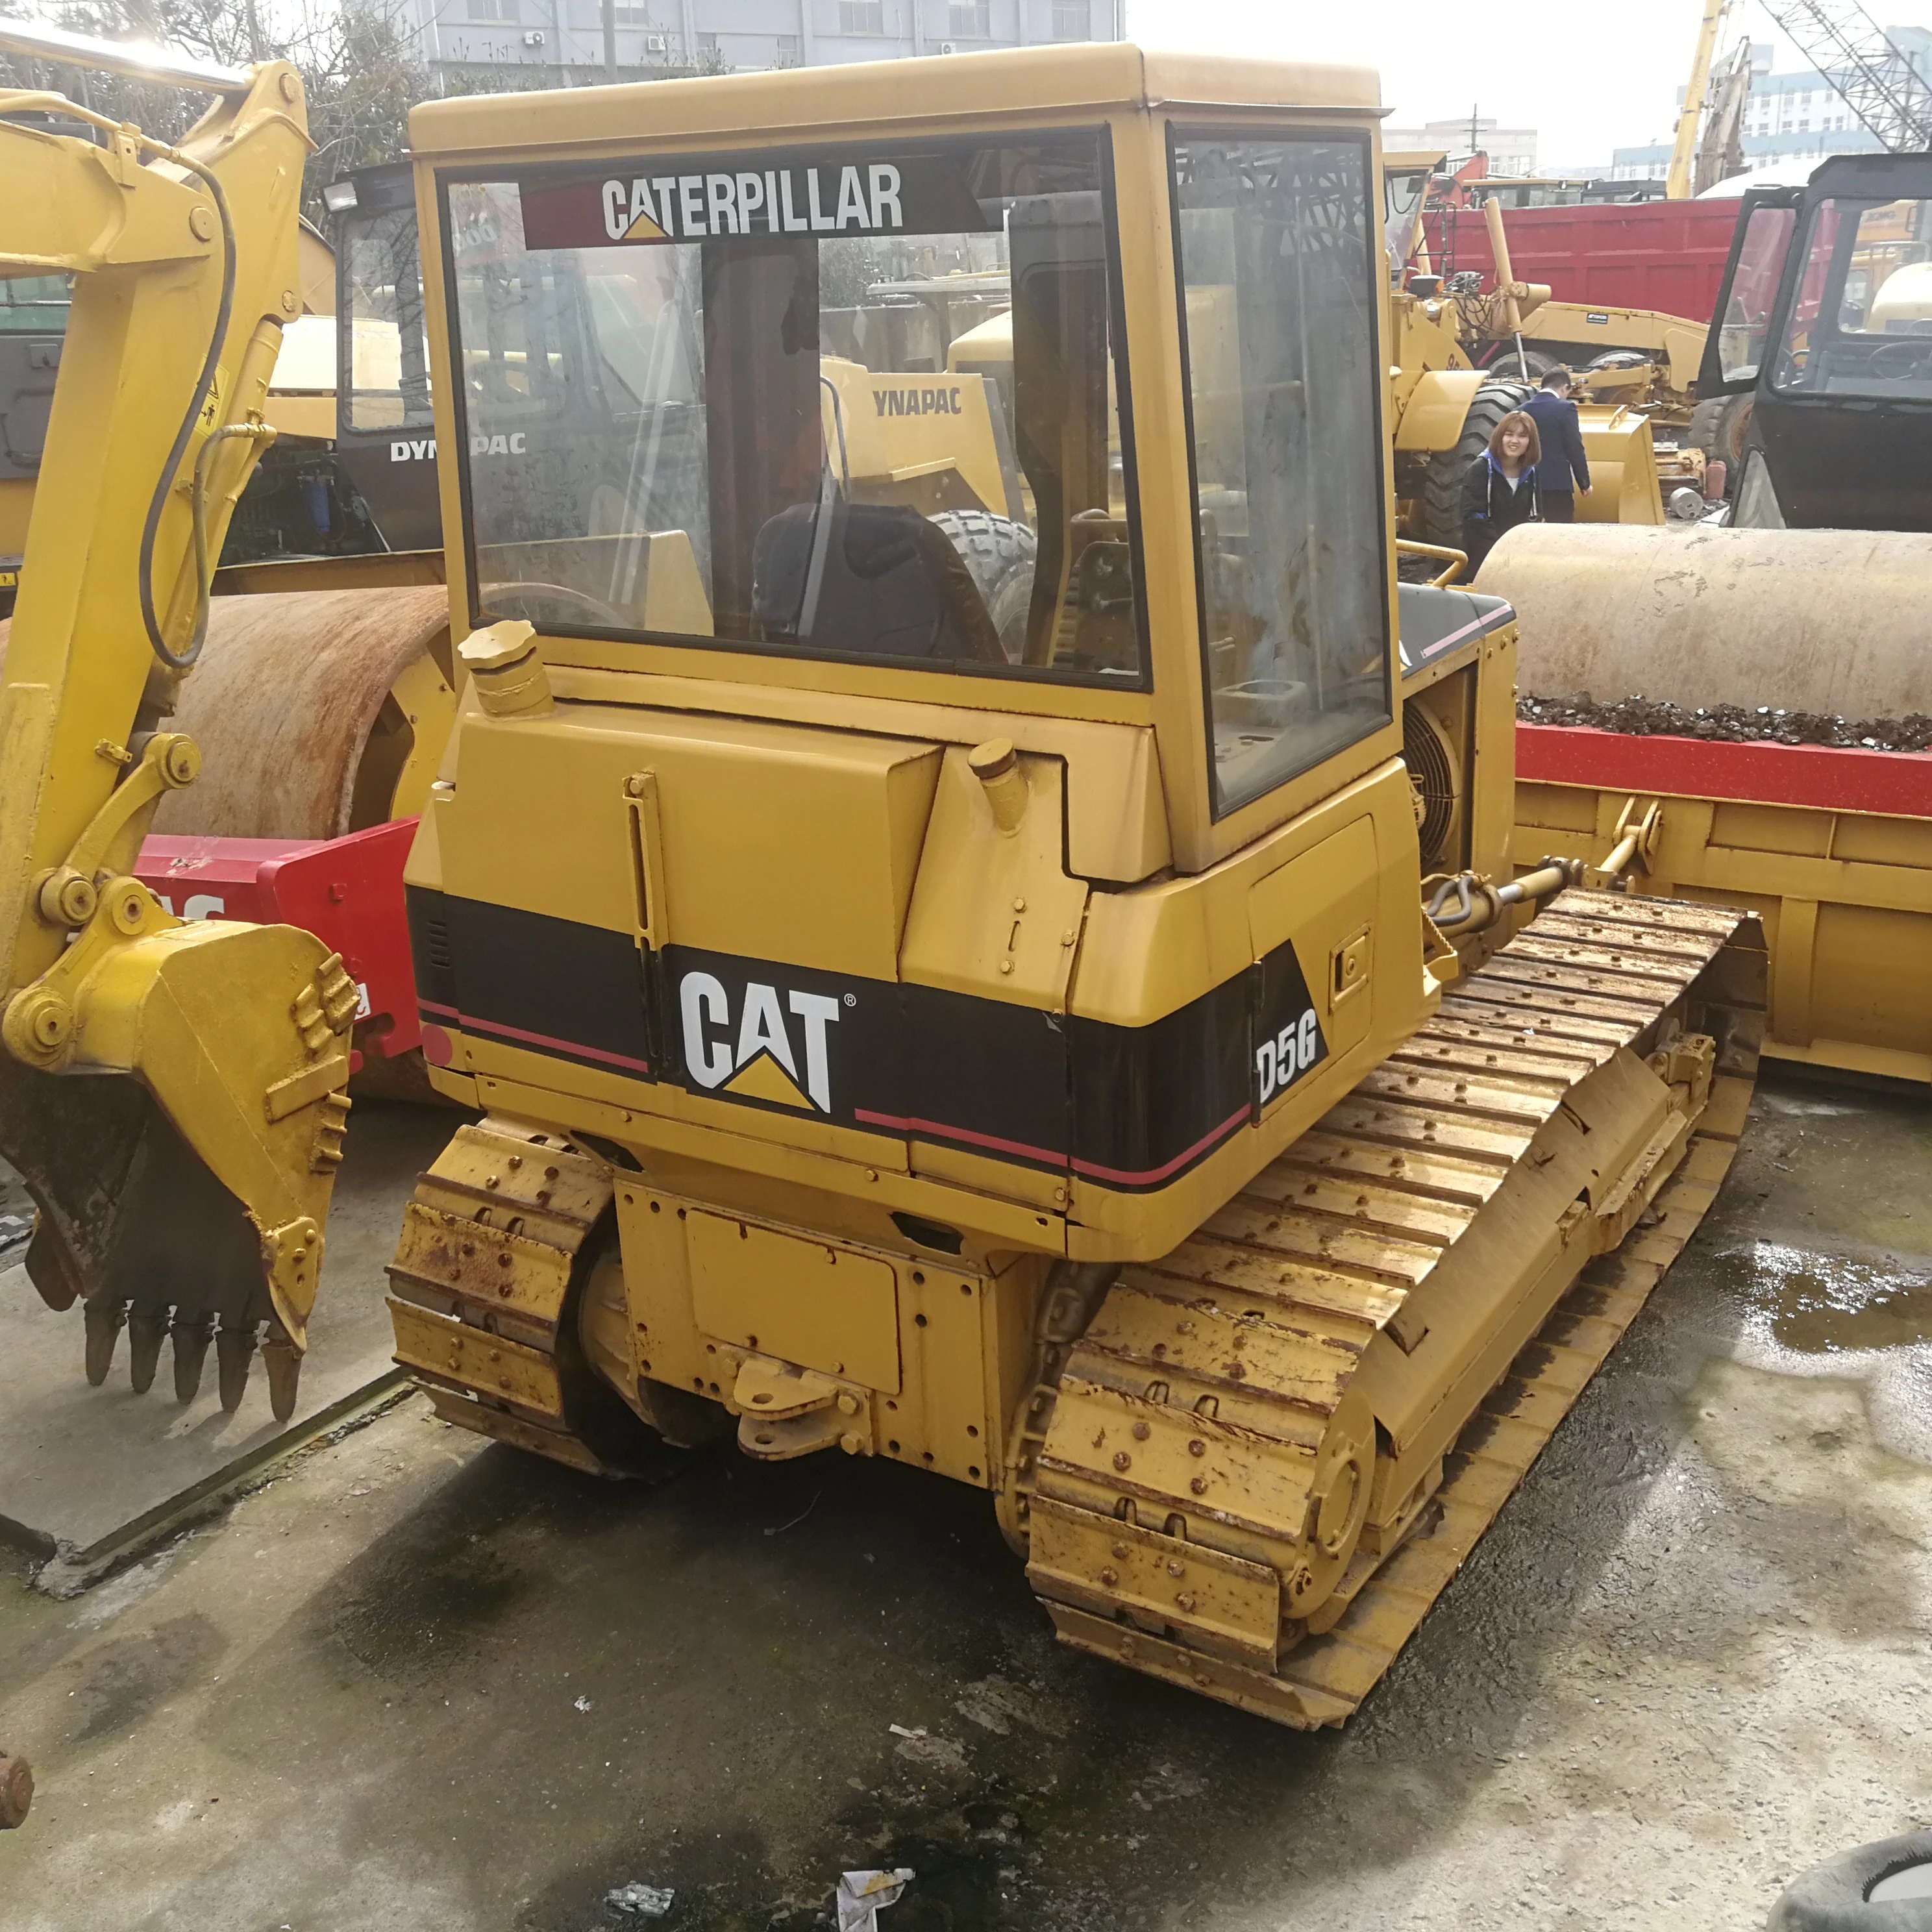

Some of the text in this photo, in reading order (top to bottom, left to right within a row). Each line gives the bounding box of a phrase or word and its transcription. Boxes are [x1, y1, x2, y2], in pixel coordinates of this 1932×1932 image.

[602, 164, 903, 240] CATERPILLAR
[873, 387, 961, 416] YNAPAC
[1256, 1008, 1317, 1104] D5G
